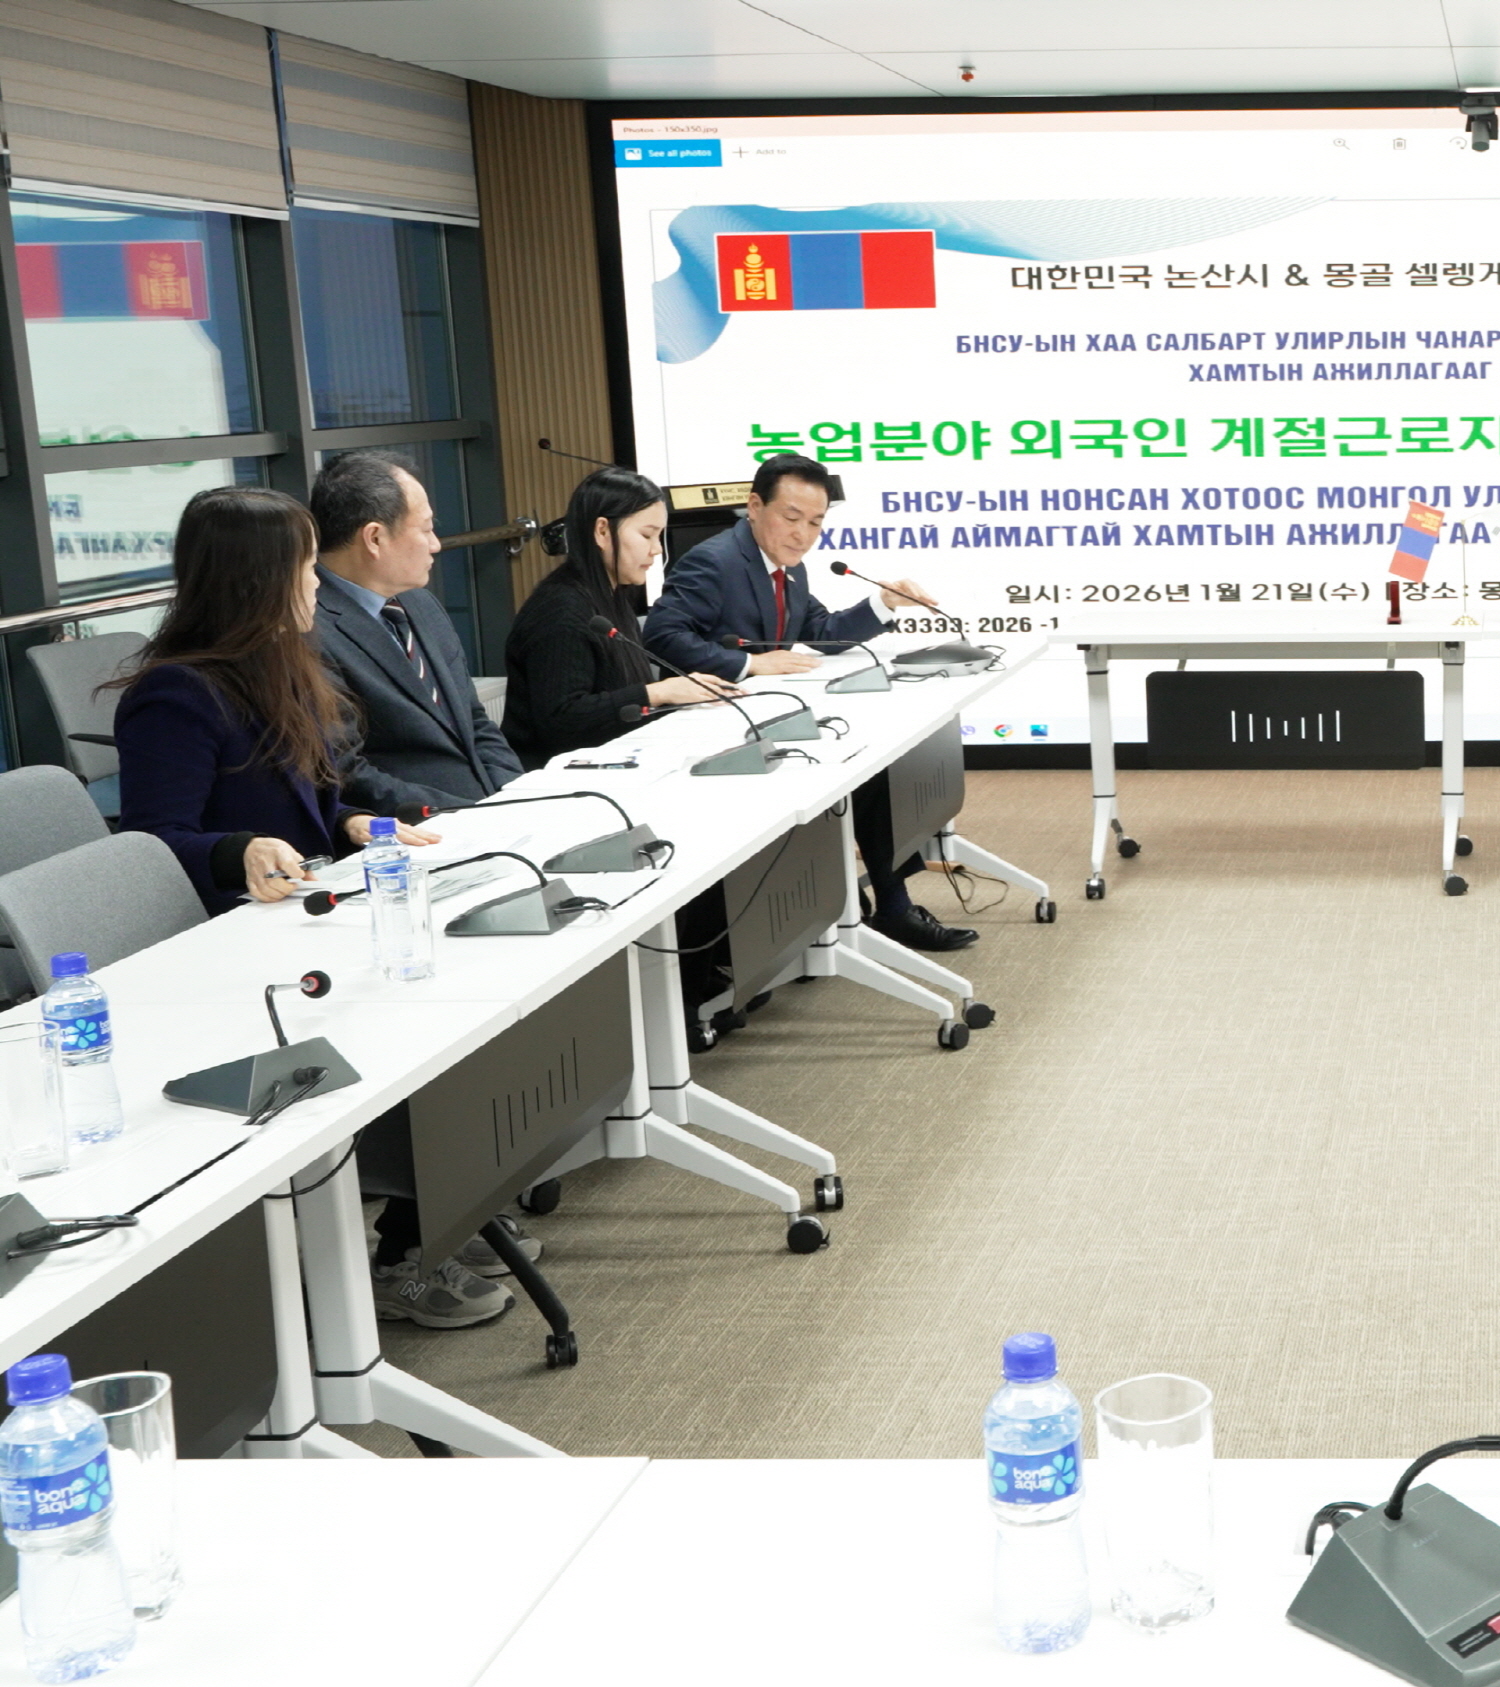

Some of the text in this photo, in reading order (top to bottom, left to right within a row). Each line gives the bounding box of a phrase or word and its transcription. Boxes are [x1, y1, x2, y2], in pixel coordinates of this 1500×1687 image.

[648, 148, 713, 159] See all photos
[755, 148, 777, 156] Add
[1010, 264, 1153, 291] 대한민국
[1163, 263, 1268, 290] 논산시
[1284, 263, 1310, 288] &
[1323, 263, 1394, 289] 몽골
[956, 334, 1076, 355] БНСУ-ЫН
[1086, 333, 1137, 353] ХАА
[1146, 332, 1266, 353] САЛБАРТ
[1275, 331, 1406, 352] УЛИРЛЫН
[1189, 362, 1303, 383] ХАМТЫН
[1312, 361, 1492, 382] АЖИЛЛАГААГ
[746, 420, 992, 464] 농업분야
[1010, 417, 1188, 461] 외국인
[881, 489, 1029, 514] БНСУ-ЫН
[1040, 488, 1169, 512] НОНСАН
[1181, 486, 1305, 511] ХОТООС
[1317, 485, 1451, 509] МОНГОЛ
[951, 522, 1121, 549] АЙМАГТАЙ
[1133, 523, 1274, 547] ХАМТЫН
[1005, 584, 1072, 604] 일시:
[1082, 583, 1190, 603] 2026년
[1200, 582, 1241, 603] 1월
[1252, 582, 1370, 603] 21일(수)
[978, 616, 1032, 633] 2026
[400, 1280, 426, 1301] N
